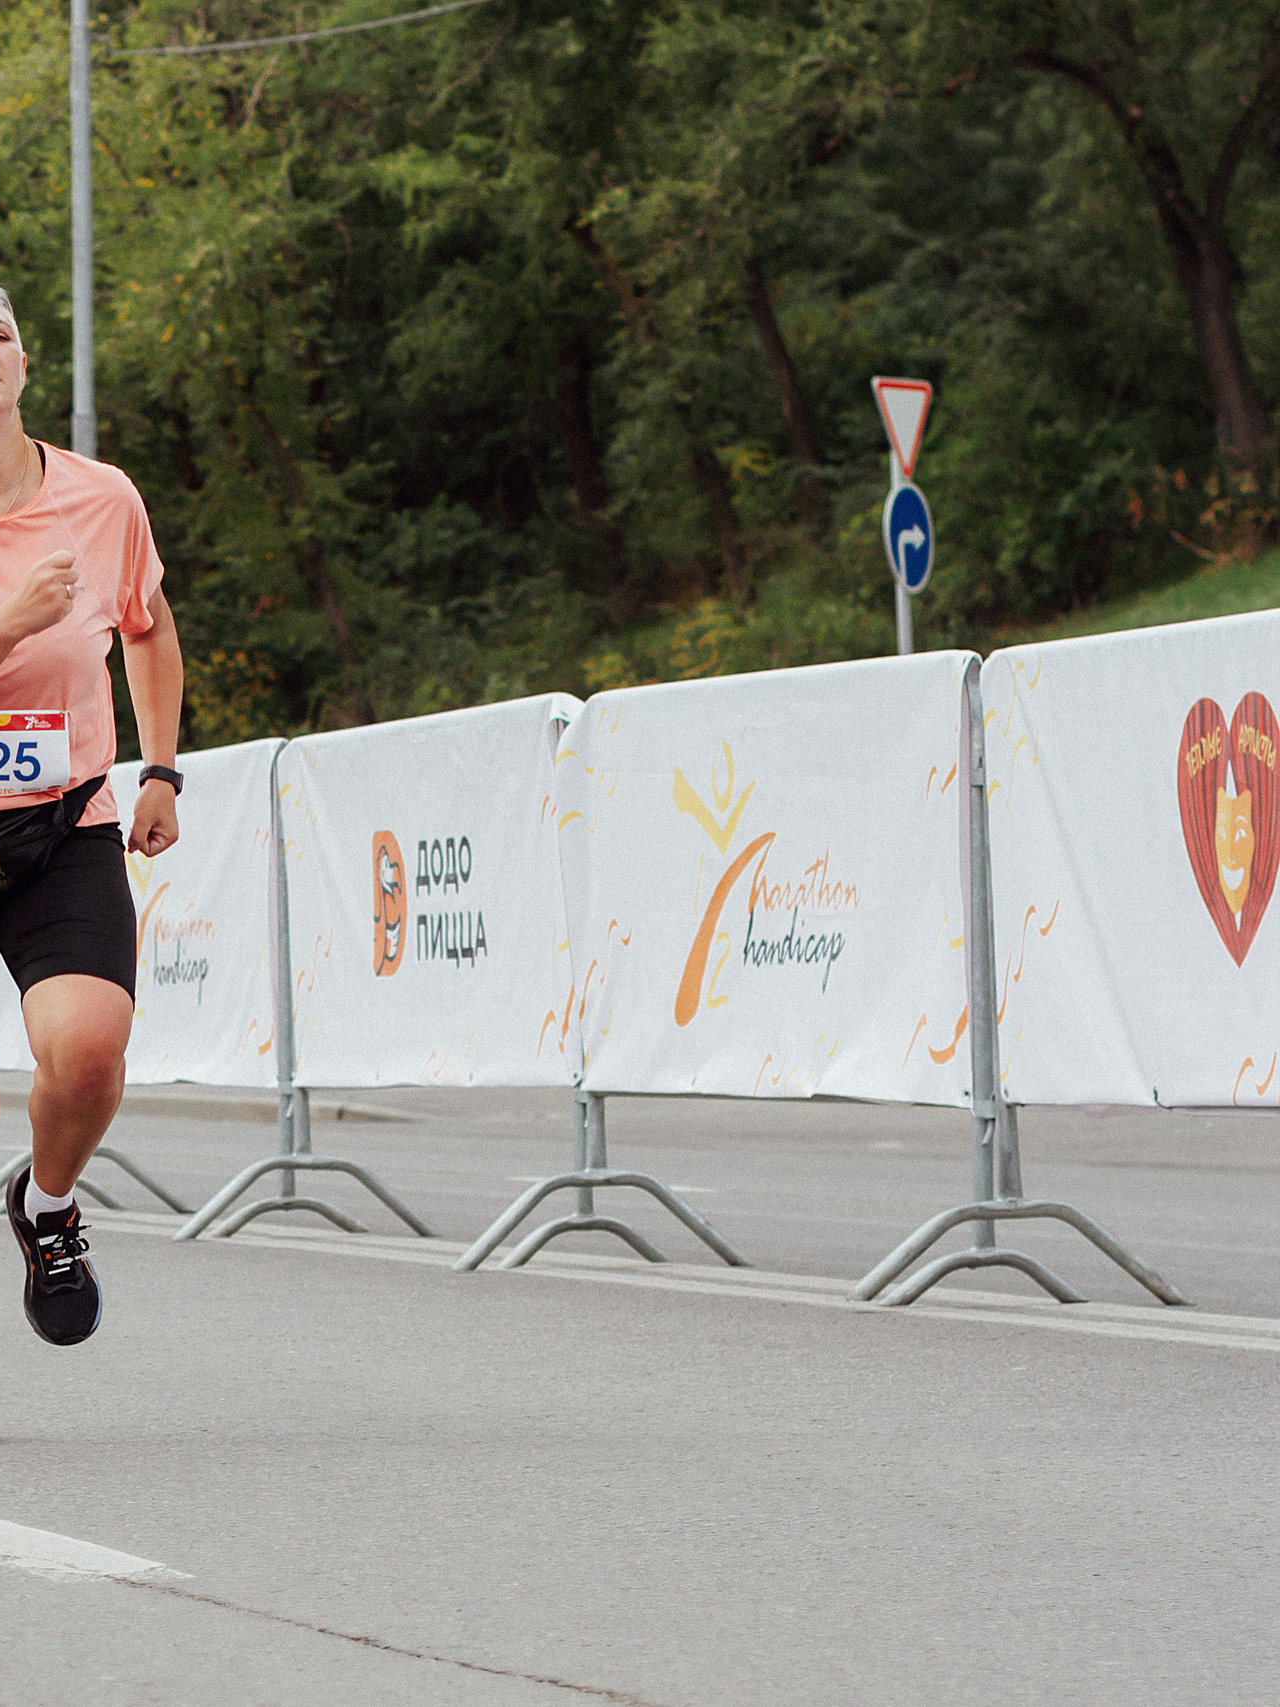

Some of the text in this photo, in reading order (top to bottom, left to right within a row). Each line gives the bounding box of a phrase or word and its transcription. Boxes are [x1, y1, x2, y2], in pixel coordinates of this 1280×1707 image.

[416, 835, 472, 897] ДОДО
[416, 909, 488, 970] ПИЦЦА
[743, 905, 846, 995] handicap
